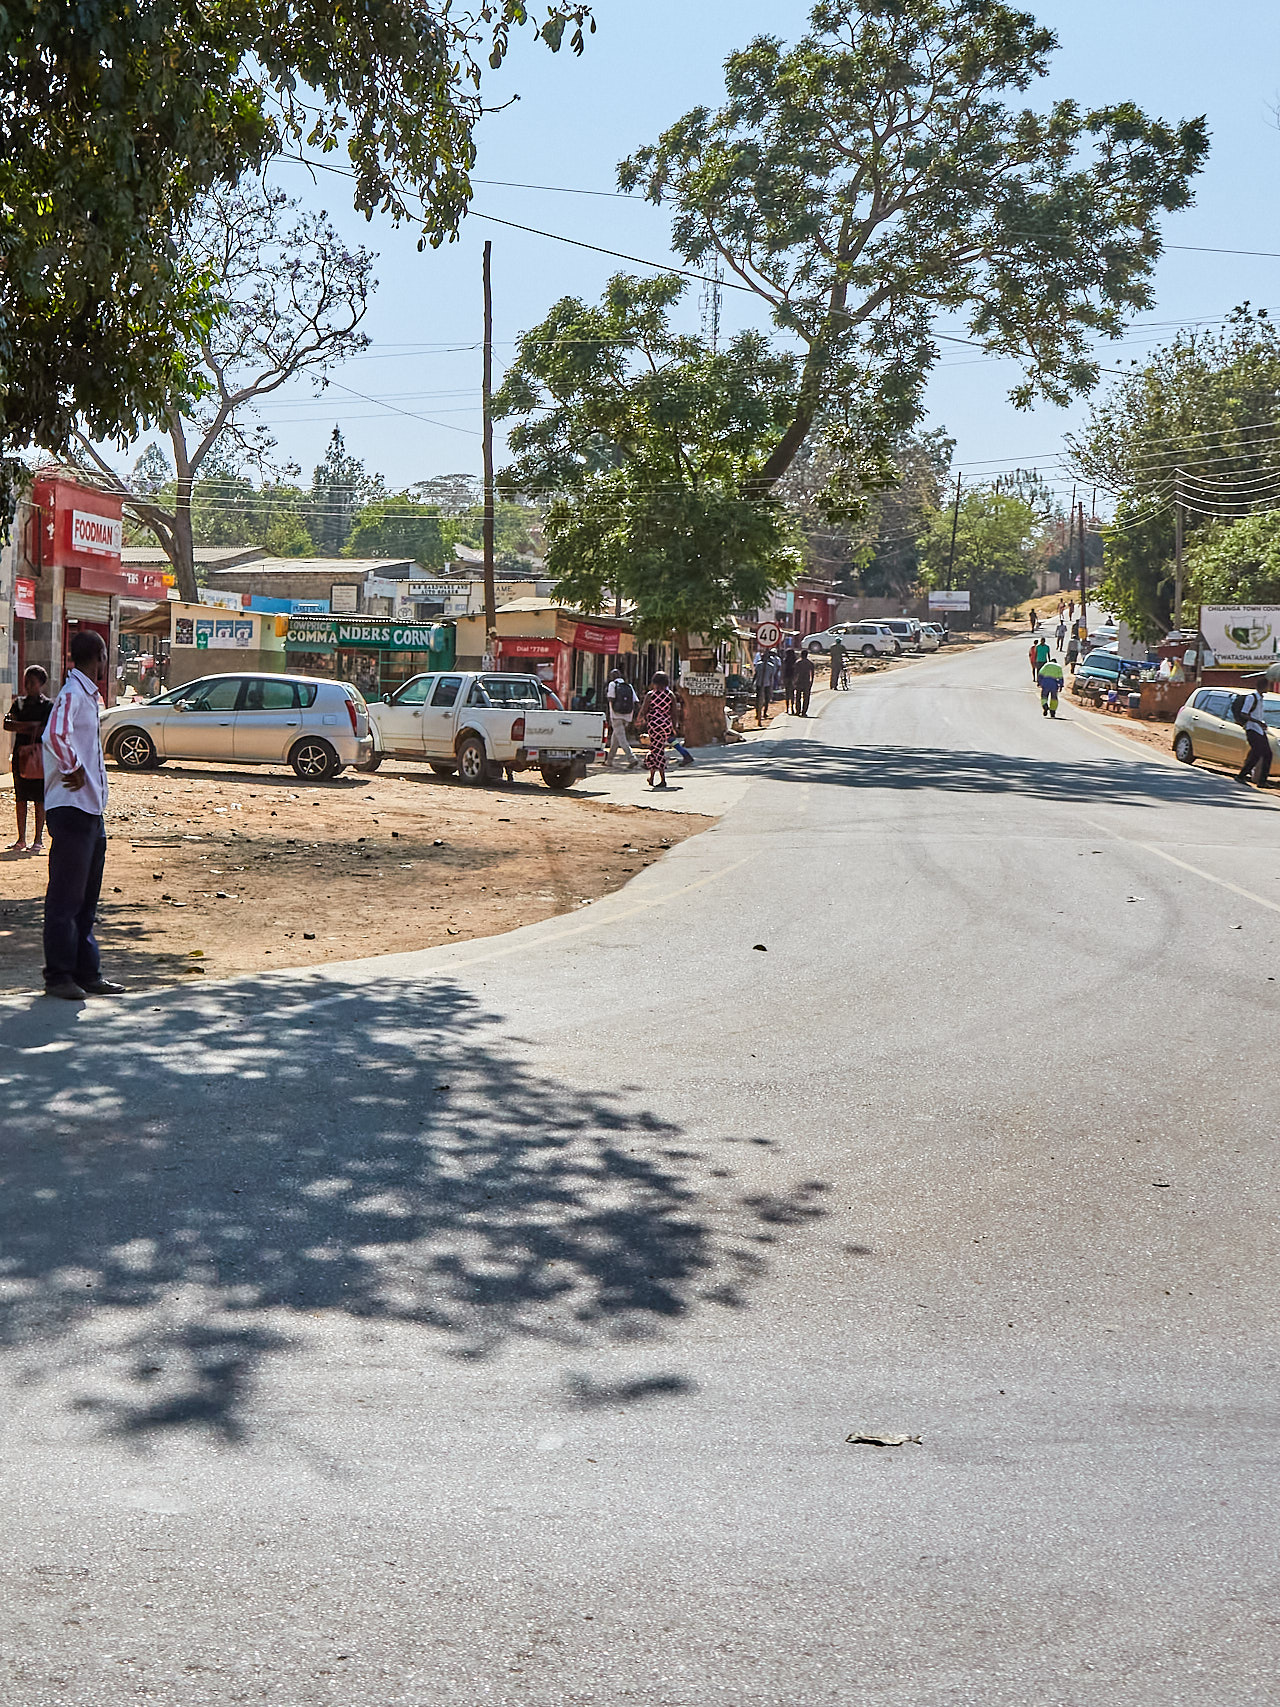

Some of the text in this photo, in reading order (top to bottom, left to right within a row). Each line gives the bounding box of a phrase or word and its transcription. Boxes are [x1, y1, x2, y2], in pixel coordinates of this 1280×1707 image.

[75, 519, 113, 546] FOODMAN
[393, 629, 431, 646] CORN
[760, 628, 778, 642] 40
